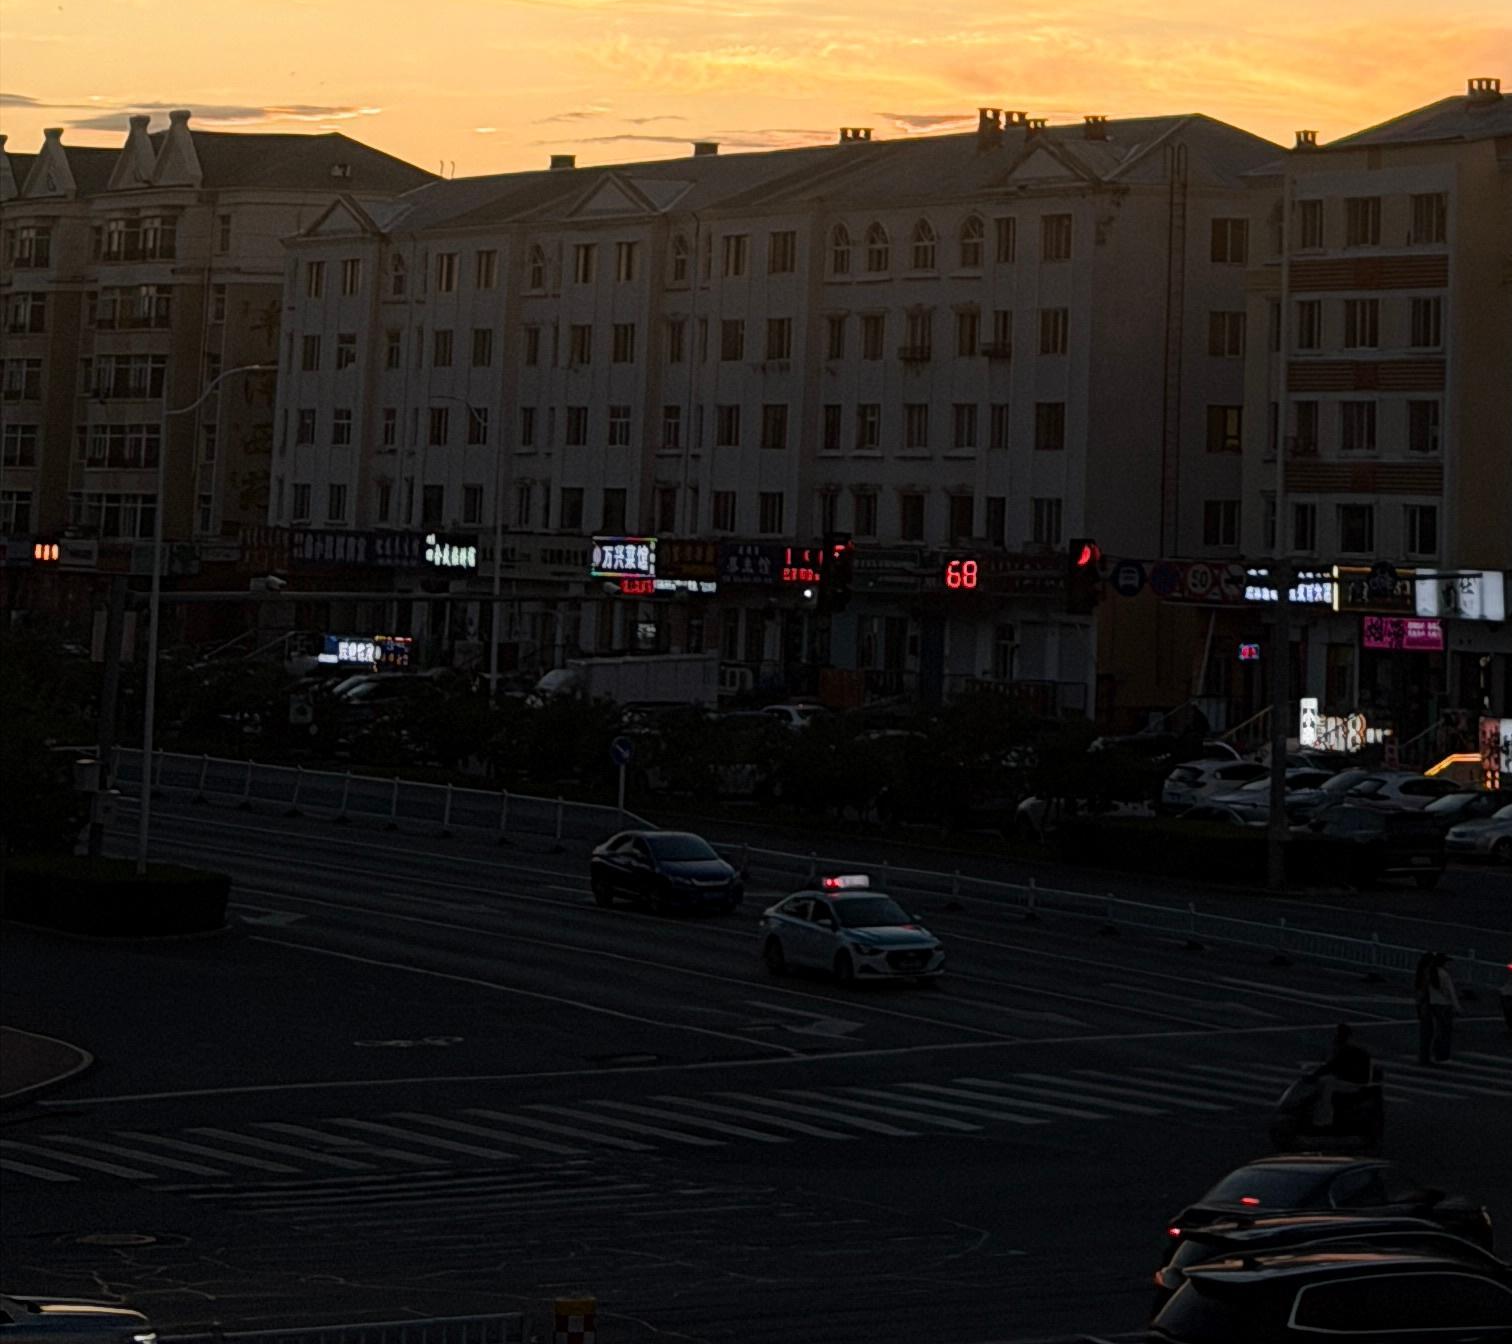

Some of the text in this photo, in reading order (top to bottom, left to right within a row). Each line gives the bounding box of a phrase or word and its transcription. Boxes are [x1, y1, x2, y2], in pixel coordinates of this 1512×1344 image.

[601, 544, 649, 571] 万兴菜馆
[945, 559, 978, 589] 68
